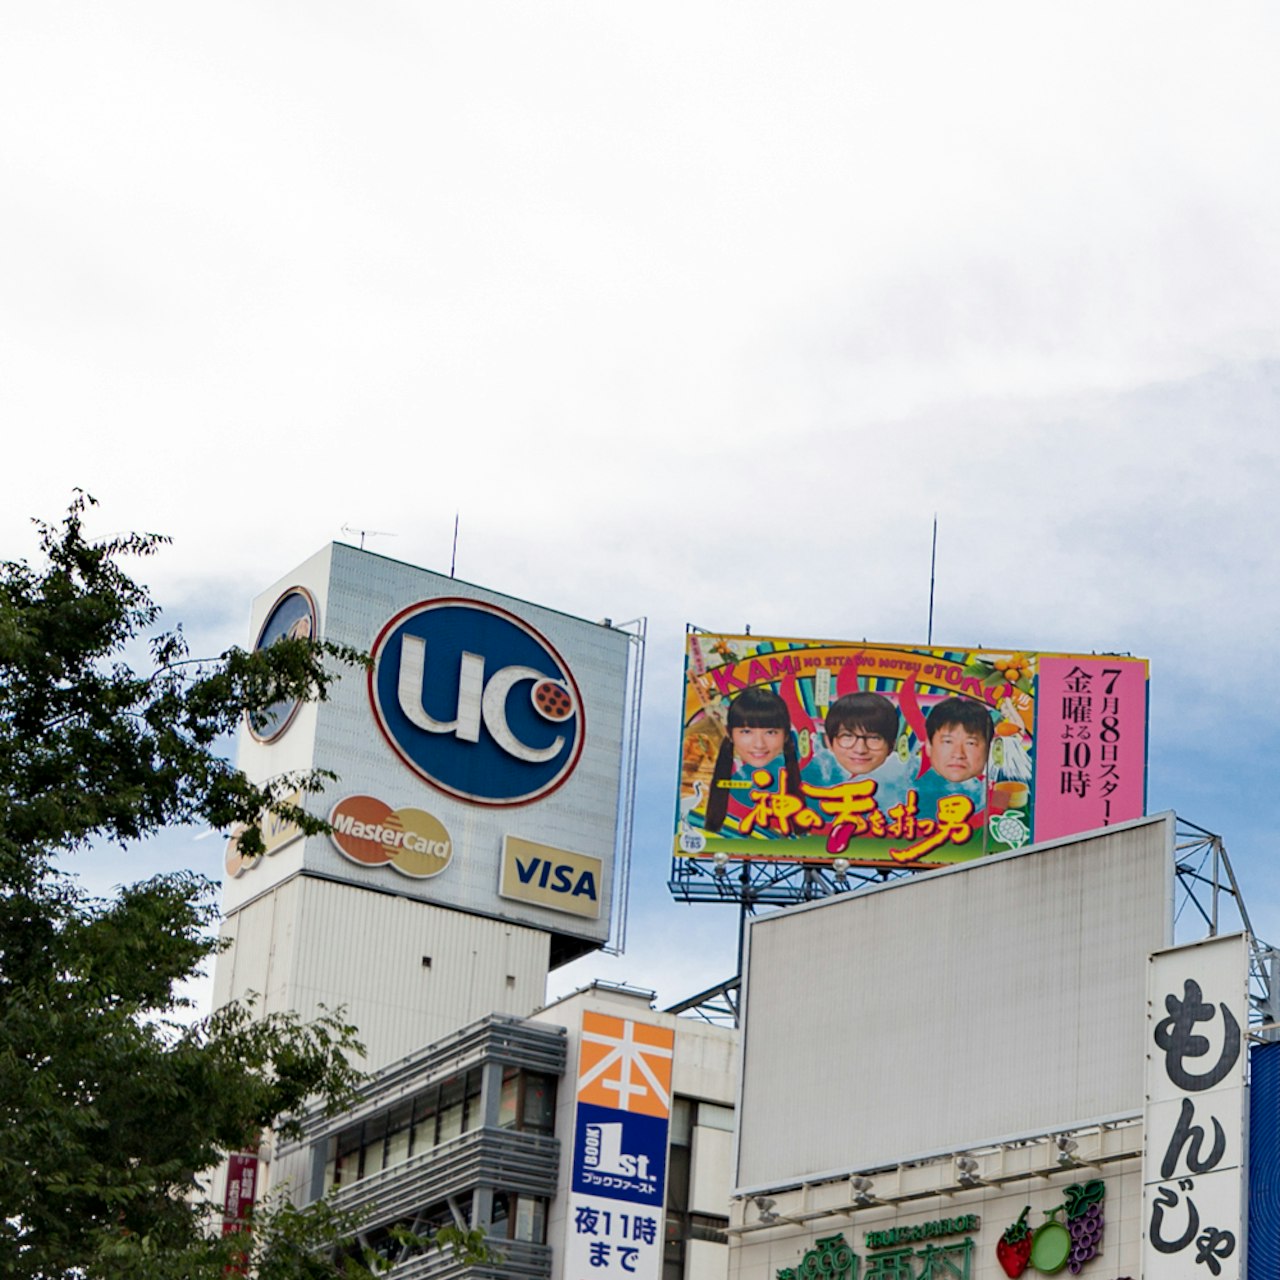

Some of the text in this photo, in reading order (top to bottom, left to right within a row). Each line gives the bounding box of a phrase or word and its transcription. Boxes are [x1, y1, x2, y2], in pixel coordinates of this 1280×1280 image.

[398, 634, 565, 763] UC
[712, 656, 800, 695] KAMI
[804, 657, 821, 668] NO
[879, 658, 921, 672] MOTSU
[1060, 666, 1093, 798] 金曜よる10時
[1098, 668, 1122, 826] 7月8日スター
[333, 811, 450, 862] MasterCard
[515, 855, 597, 901] VISA
[579, 1020, 673, 1111] 本
[584, 1124, 600, 1171] BOOK
[1150, 979, 1240, 1277] もんじゃ
[582, 1172, 656, 1194] ブックファースト
[575, 1207, 656, 1245] 夜11時
[589, 1242, 639, 1273] まで
